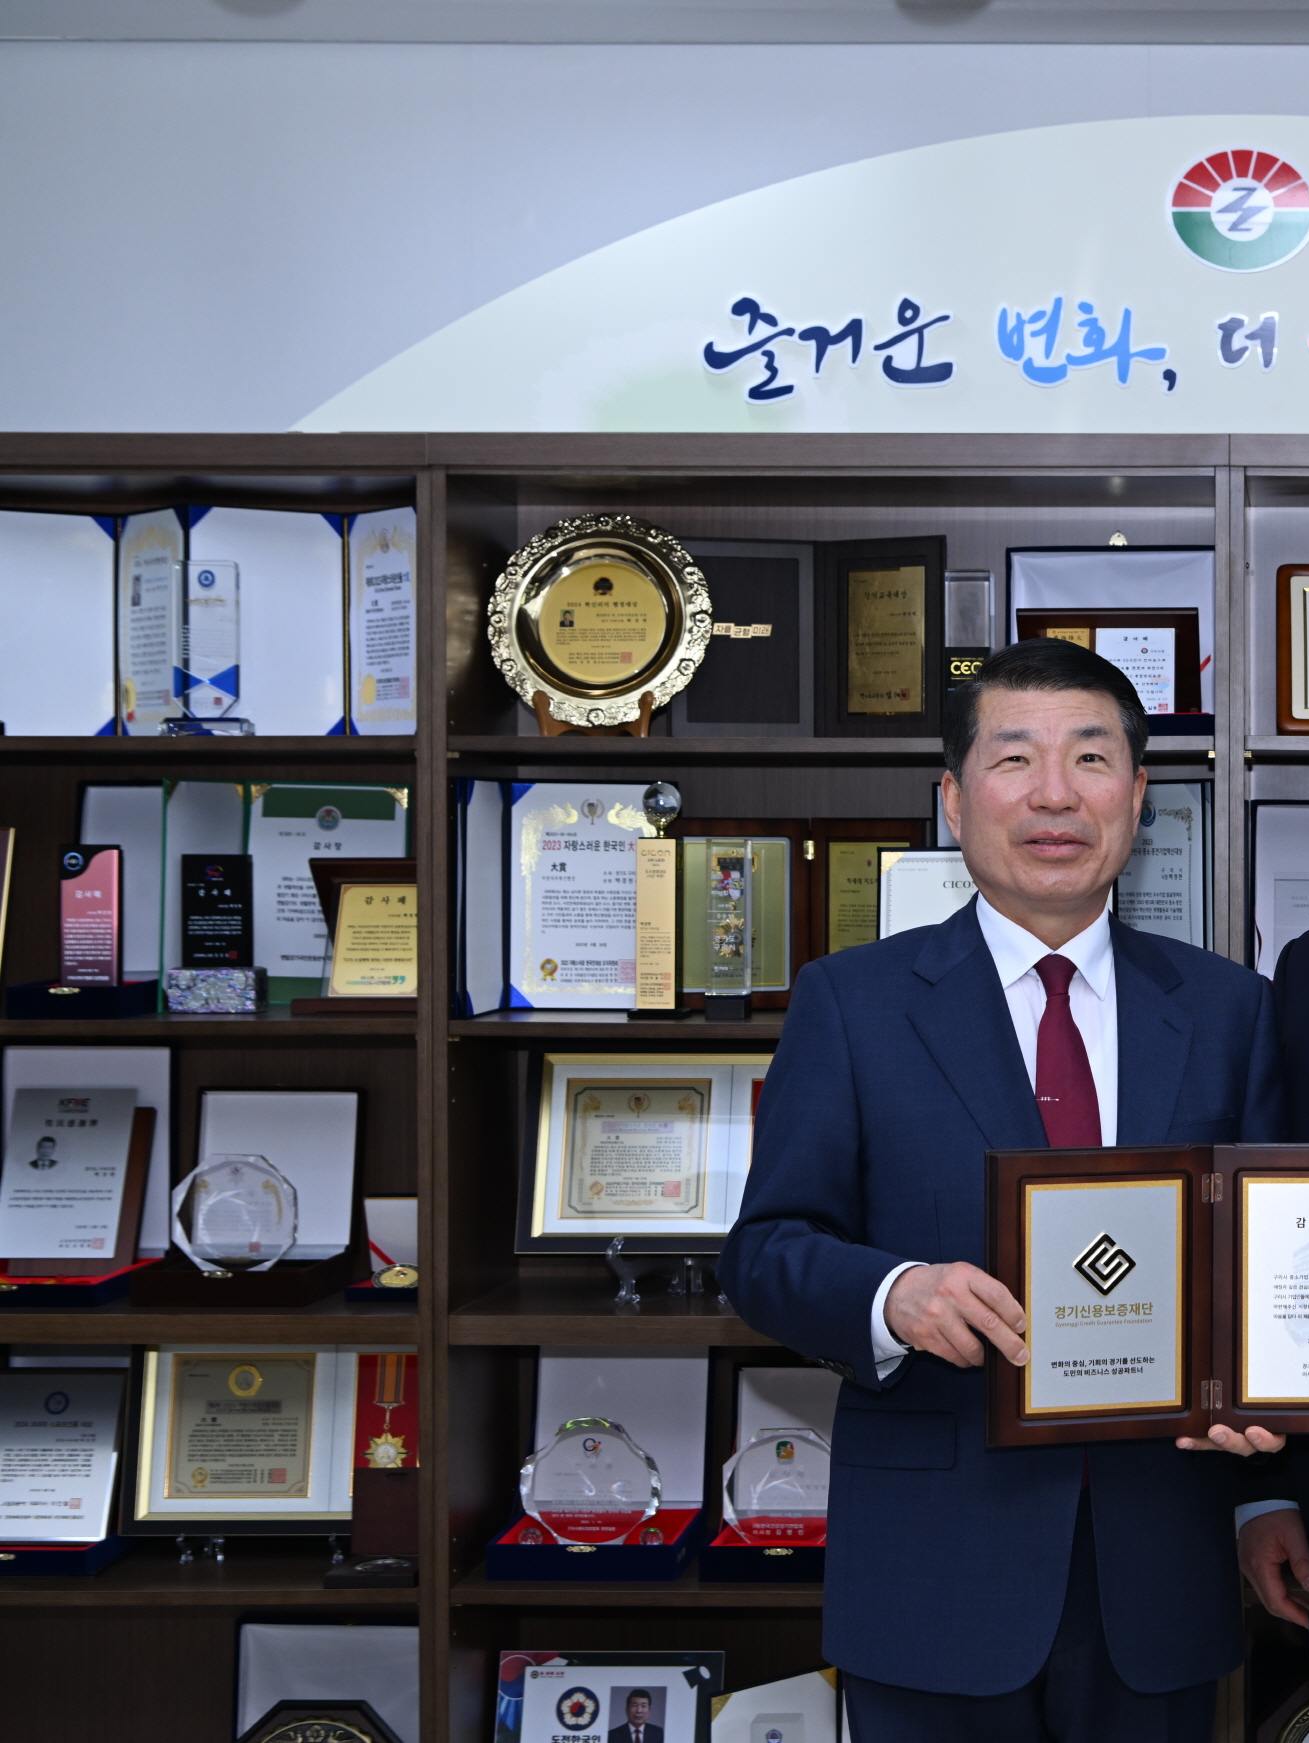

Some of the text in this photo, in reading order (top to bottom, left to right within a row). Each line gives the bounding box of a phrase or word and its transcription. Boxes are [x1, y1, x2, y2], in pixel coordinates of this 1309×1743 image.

[704, 297, 955, 400] 즐거운
[997, 295, 1180, 393] 변화,
[1217, 314, 1276, 369] 더
[542, 840, 561, 850] 2023
[564, 840, 601, 852] 자랑스러운
[603, 840, 625, 852] 한국인
[1055, 1302, 1153, 1320] 경기신용보증재단
[1051, 1361, 1071, 1369] 변화의
[1084, 1368, 1110, 1376] 비즈니스
[1111, 1367, 1143, 1375] 성공파트너
